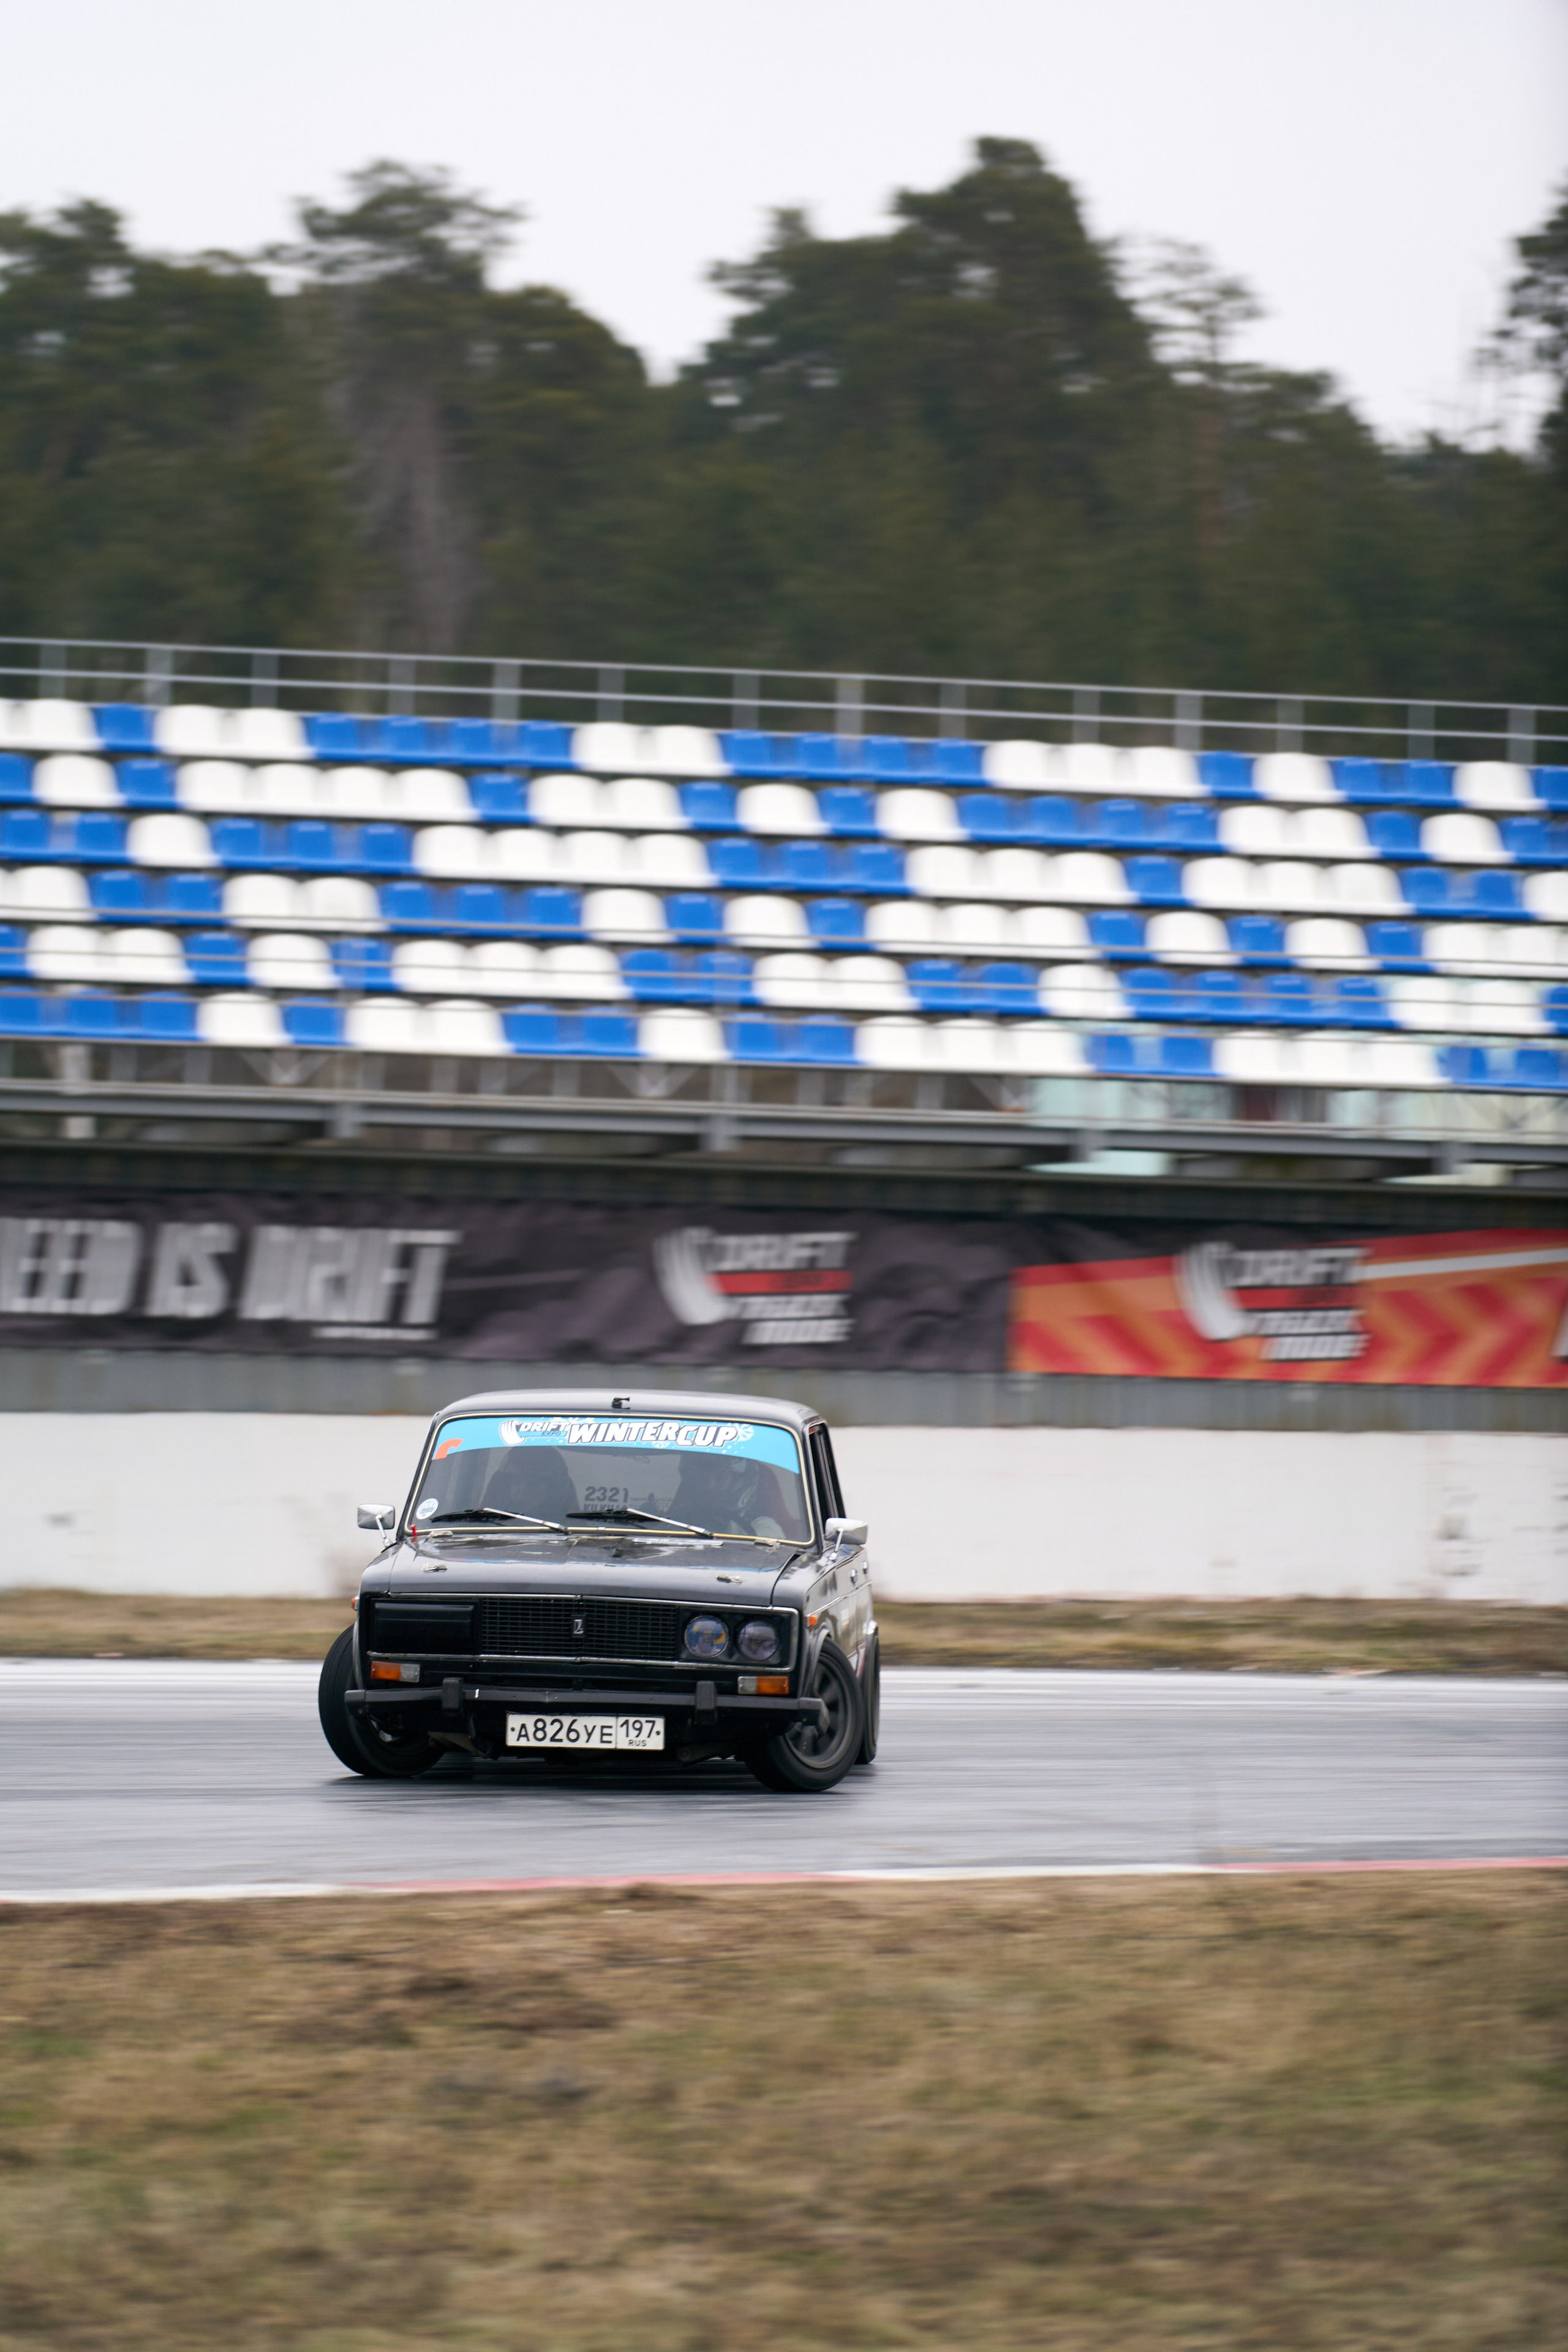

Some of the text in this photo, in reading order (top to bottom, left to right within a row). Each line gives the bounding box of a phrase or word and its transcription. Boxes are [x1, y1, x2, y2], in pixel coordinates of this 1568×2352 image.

[707, 1232, 858, 1270] DRIFT
[519, 1421, 570, 1432] DRIFT
[584, 1486, 629, 1502] 2321
[620, 1719, 656, 1739] 197
